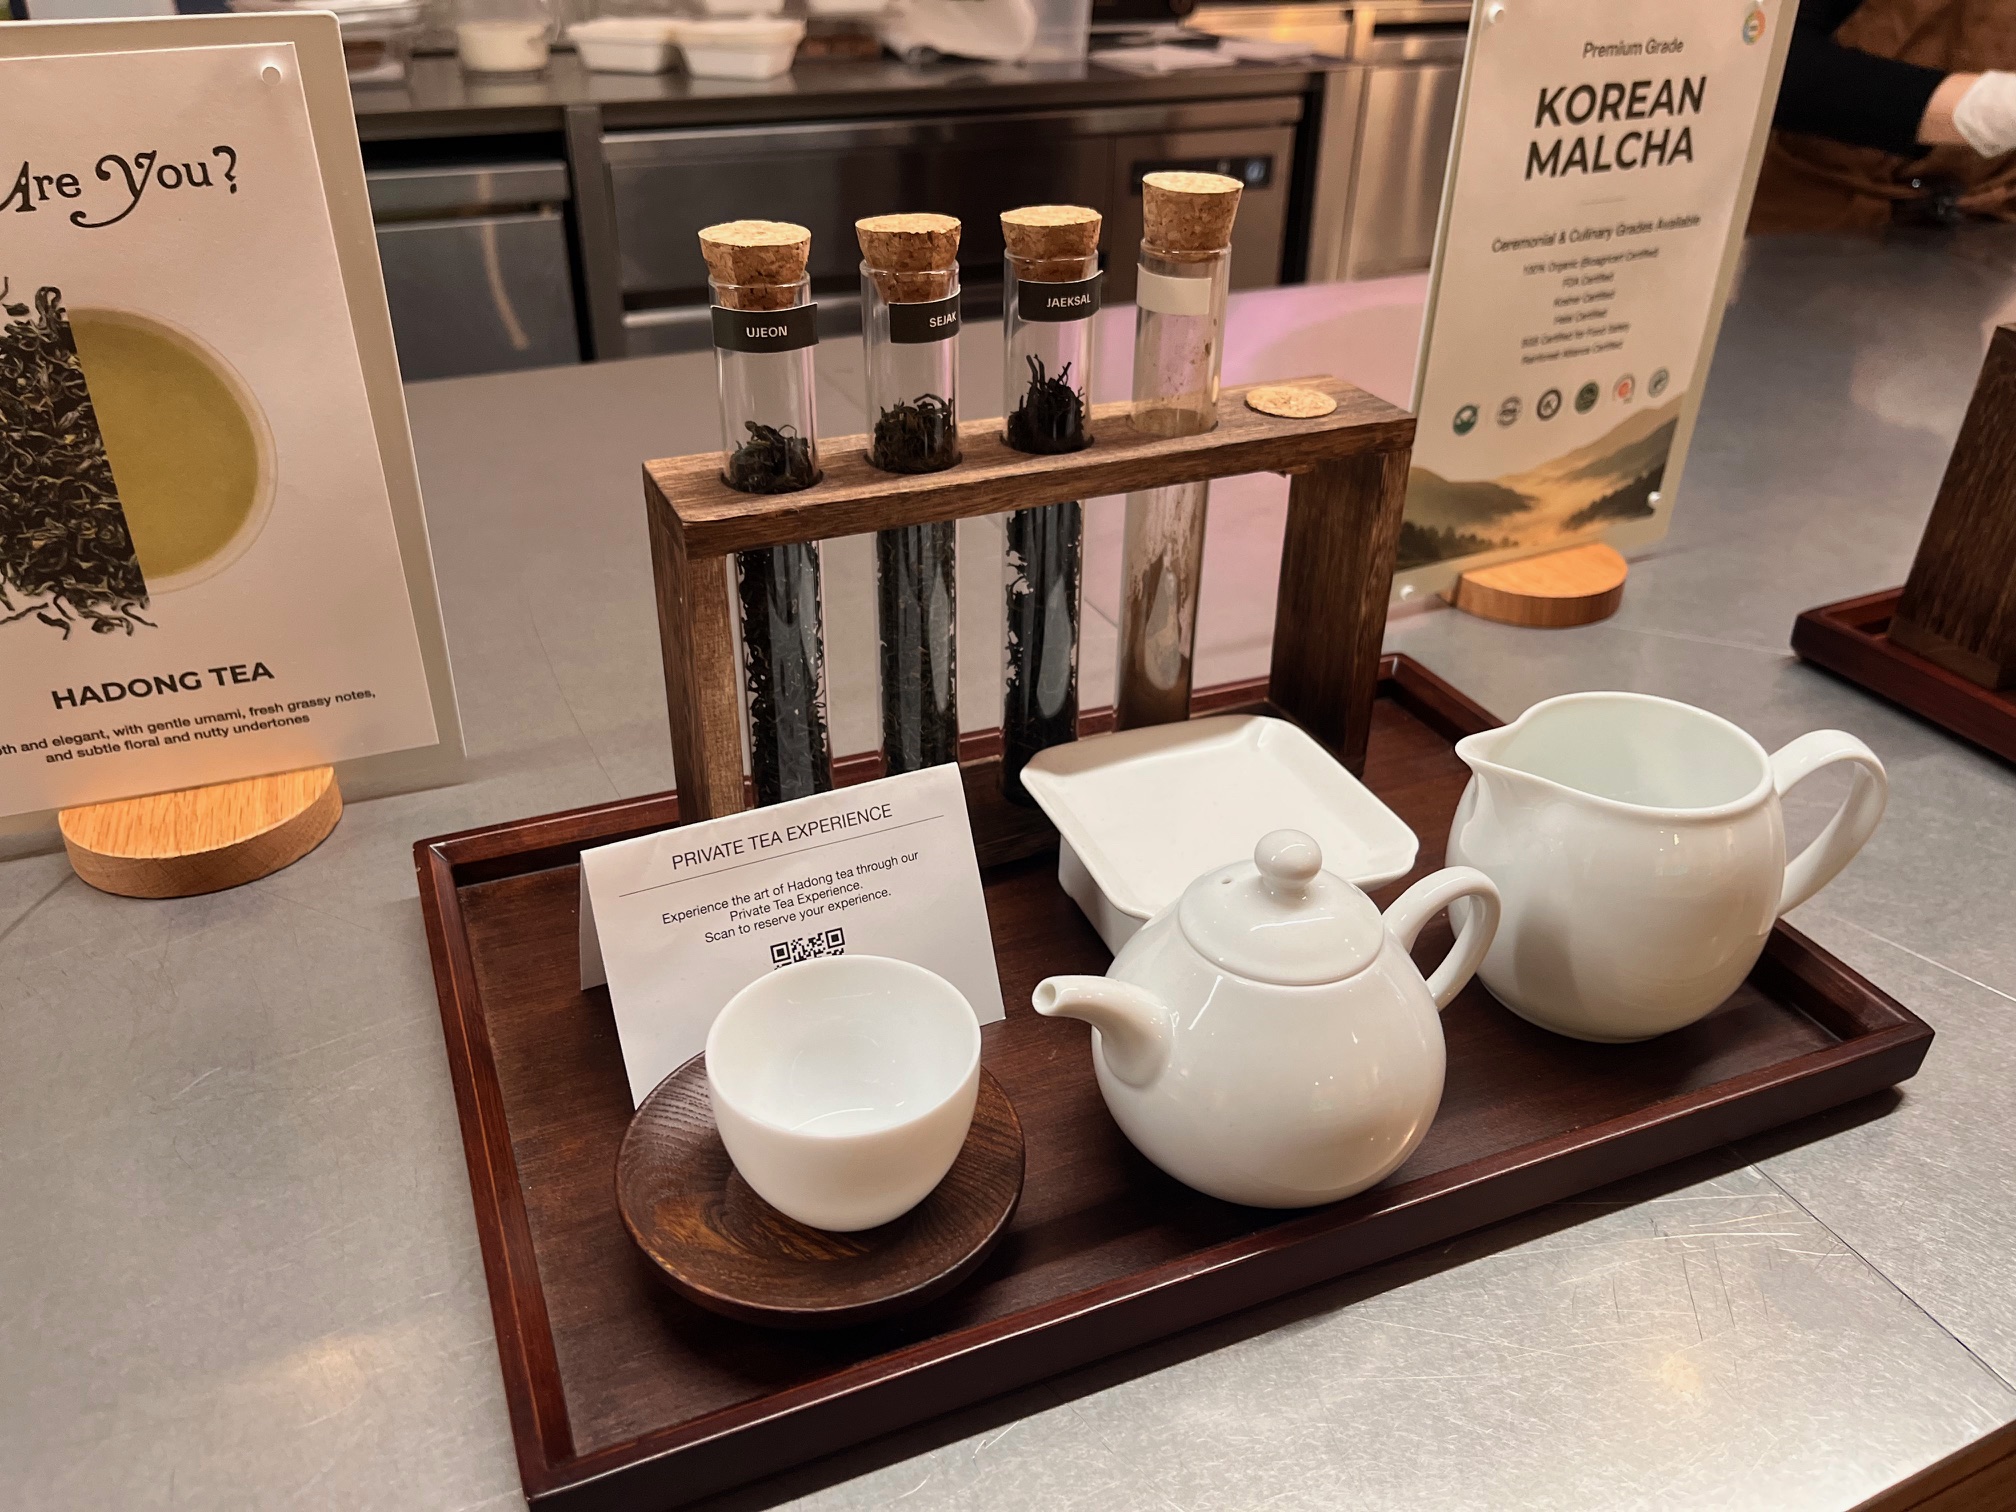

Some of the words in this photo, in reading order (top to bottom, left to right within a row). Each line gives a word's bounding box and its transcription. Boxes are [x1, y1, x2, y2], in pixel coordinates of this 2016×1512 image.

[1582, 40, 1643, 59] Premium
[1645, 37, 1684, 55] Grade
[1535, 76, 1707, 128] KOREAN
[1524, 126, 1694, 181] MALCHA
[0, 161, 82, 213] Are
[69, 145, 237, 229] You?
[1492, 232, 1556, 253] Ceremonial
[1558, 231, 1566, 244] &
[1569, 226, 1612, 242] Culinary
[1615, 219, 1653, 237] Grades
[929, 312, 957, 329] SEJAK
[1046, 293, 1091, 309] JAEKSAL
[746, 325, 788, 339] UJEON
[51, 671, 202, 710] HADONG
[208, 661, 275, 687] TEA
[21, 738, 48, 752] and
[52, 729, 110, 746] elegant,
[113, 721, 144, 737] with
[147, 715, 191, 735] gentle
[194, 708, 246, 726] umami,
[249, 701, 284, 717] fresh
[287, 696, 332, 713] grassy
[335, 688, 376, 704] notes,
[46, 749, 73, 763] and
[77, 739, 121, 758] subtle
[124, 735, 160, 752] floral
[164, 731, 191, 745] and
[194, 725, 229, 743] nutty
[232, 713, 310, 734] undertones
[672, 839, 745, 870] PRIVATE
[748, 830, 783, 849] TEA
[786, 803, 893, 841] EXPERIENCE
[662, 898, 729, 925] Experience
[731, 892, 751, 908] the
[753, 887, 770, 902] art
[773, 883, 785, 897] of
[787, 873, 833, 896] Hadong
[835, 867, 854, 880] tea
[856, 857, 898, 877] through
[901, 851, 919, 864] our
[730, 902, 771, 922] Private
[774, 896, 794, 910] Tea
[797, 881, 864, 907] Experience.
[704, 927, 736, 944] Scan
[738, 923, 751, 936] to
[753, 912, 797, 932] reserve
[799, 904, 825, 923] your
[827, 888, 892, 915] experience.
